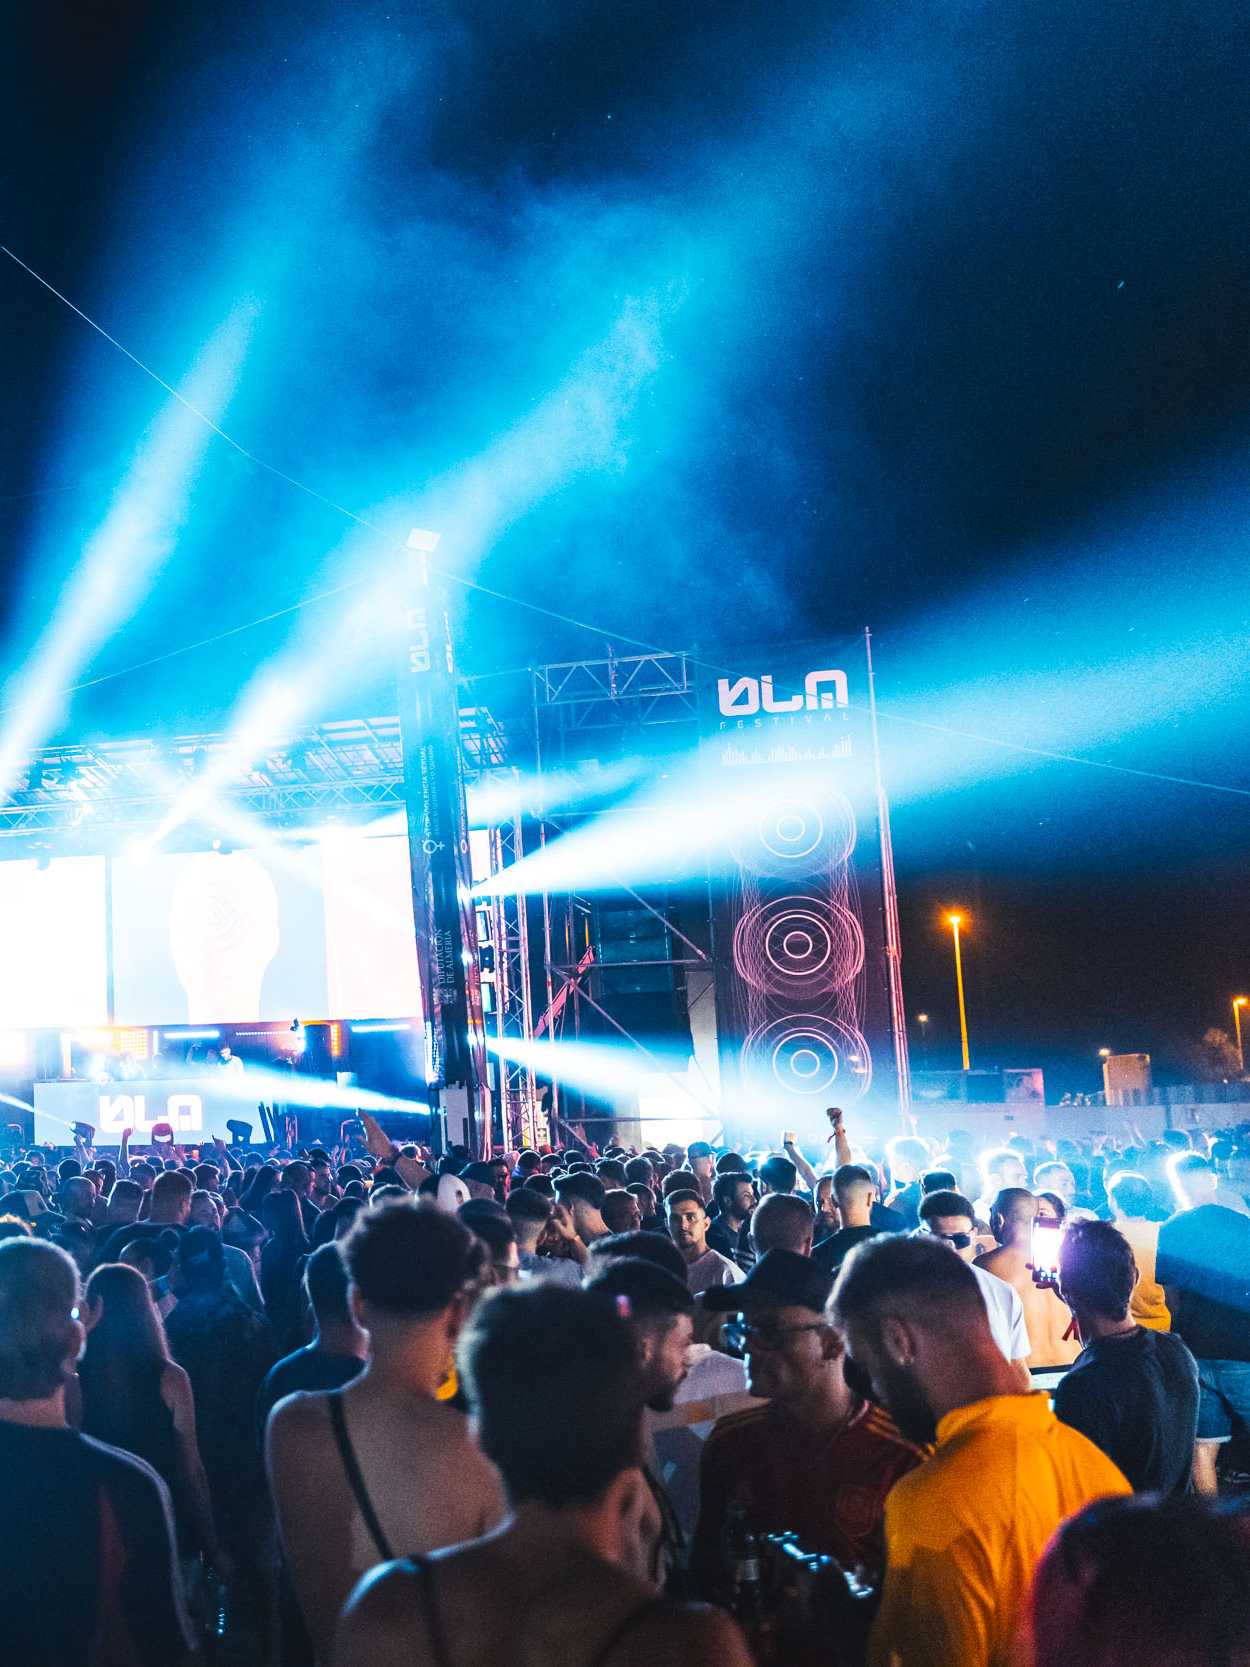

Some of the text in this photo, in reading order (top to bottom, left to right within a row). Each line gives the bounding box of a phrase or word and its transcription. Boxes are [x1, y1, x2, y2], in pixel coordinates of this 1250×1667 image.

[719, 712, 850, 730] FESTIVAL
[419, 746, 428, 774] SEXUAL
[428, 744, 436, 770] QUIERO
[421, 776, 431, 815] VIOLENCIA
[444, 930, 455, 984] DE ALMERÍA
